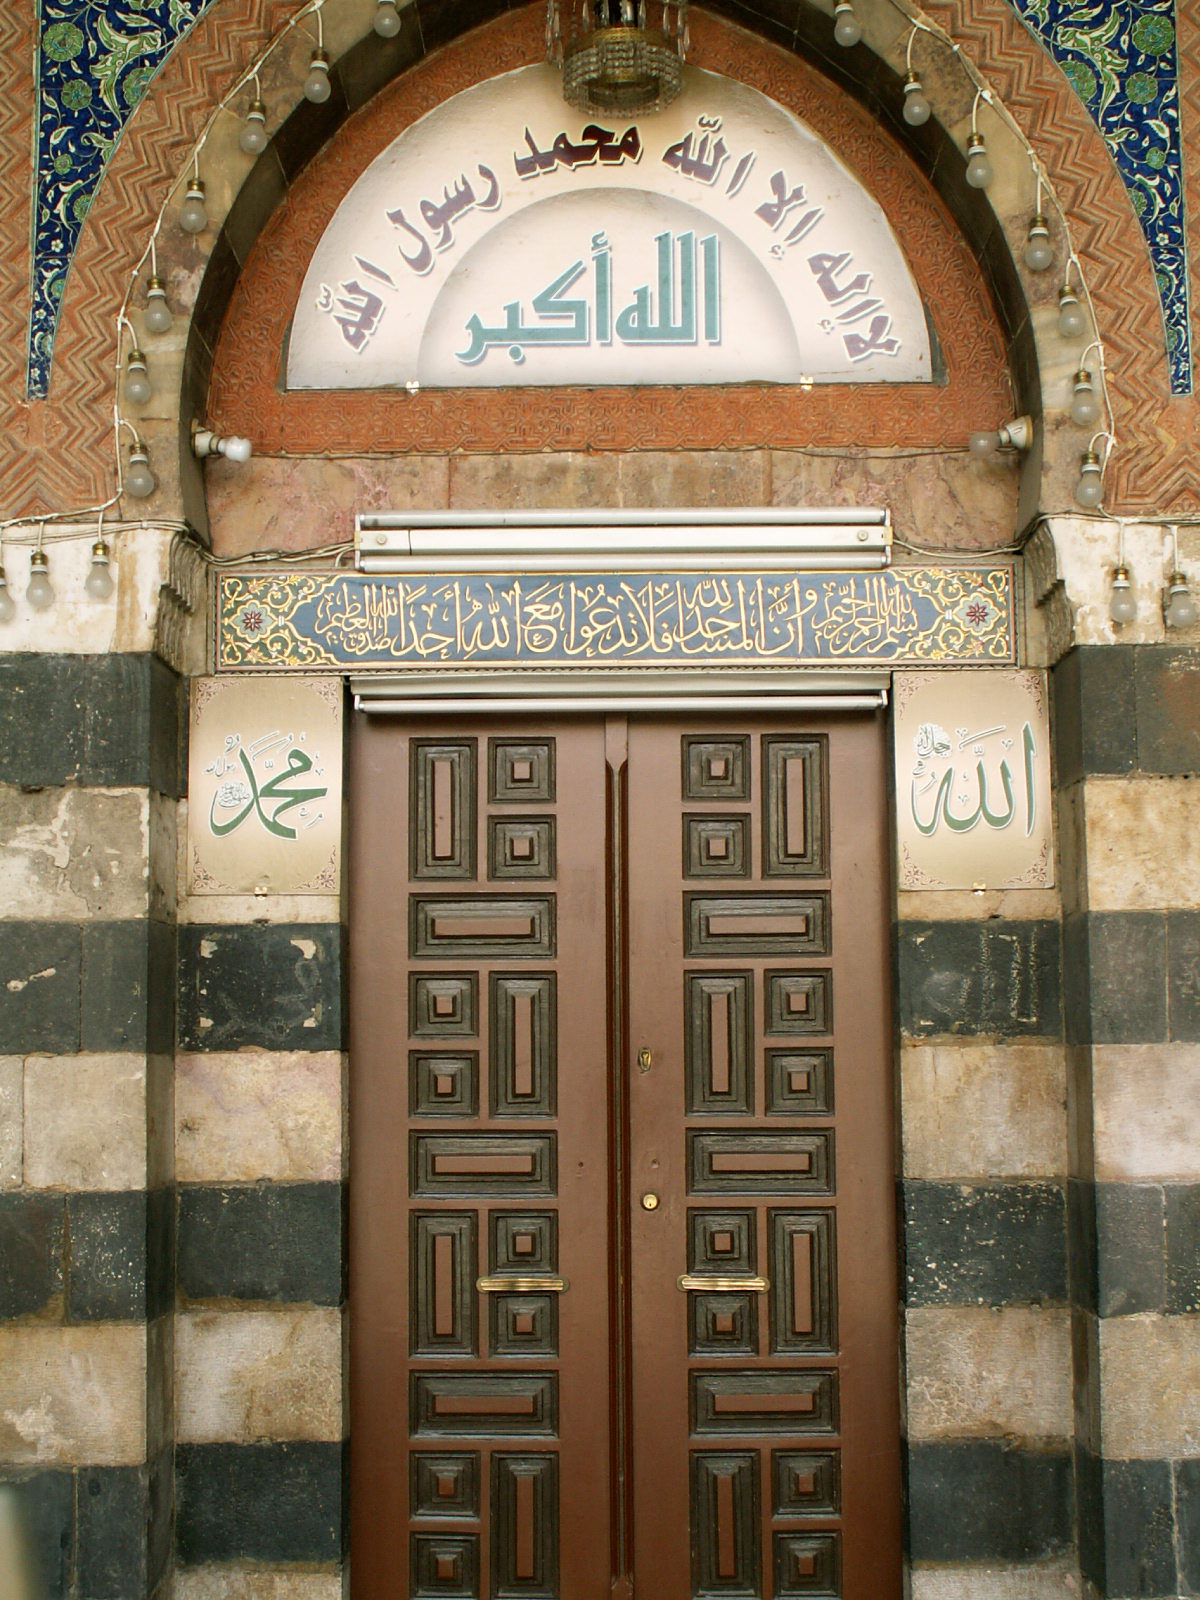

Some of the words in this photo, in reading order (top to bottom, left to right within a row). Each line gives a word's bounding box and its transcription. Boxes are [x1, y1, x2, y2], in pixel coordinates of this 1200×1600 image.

[512, 121, 643, 179] محمد
[661, 114, 755, 195] الله
[386, 163, 502, 276] رسول
[754, 169, 824, 260] إلا
[317, 254, 398, 354] الله
[455, 231, 613, 365] أكبر
[615, 231, 720, 344] الله
[808, 250, 882, 335] إله
[842, 312, 900, 362] لا
[209, 747, 328, 839] محمد
[911, 722, 1035, 836] الله
